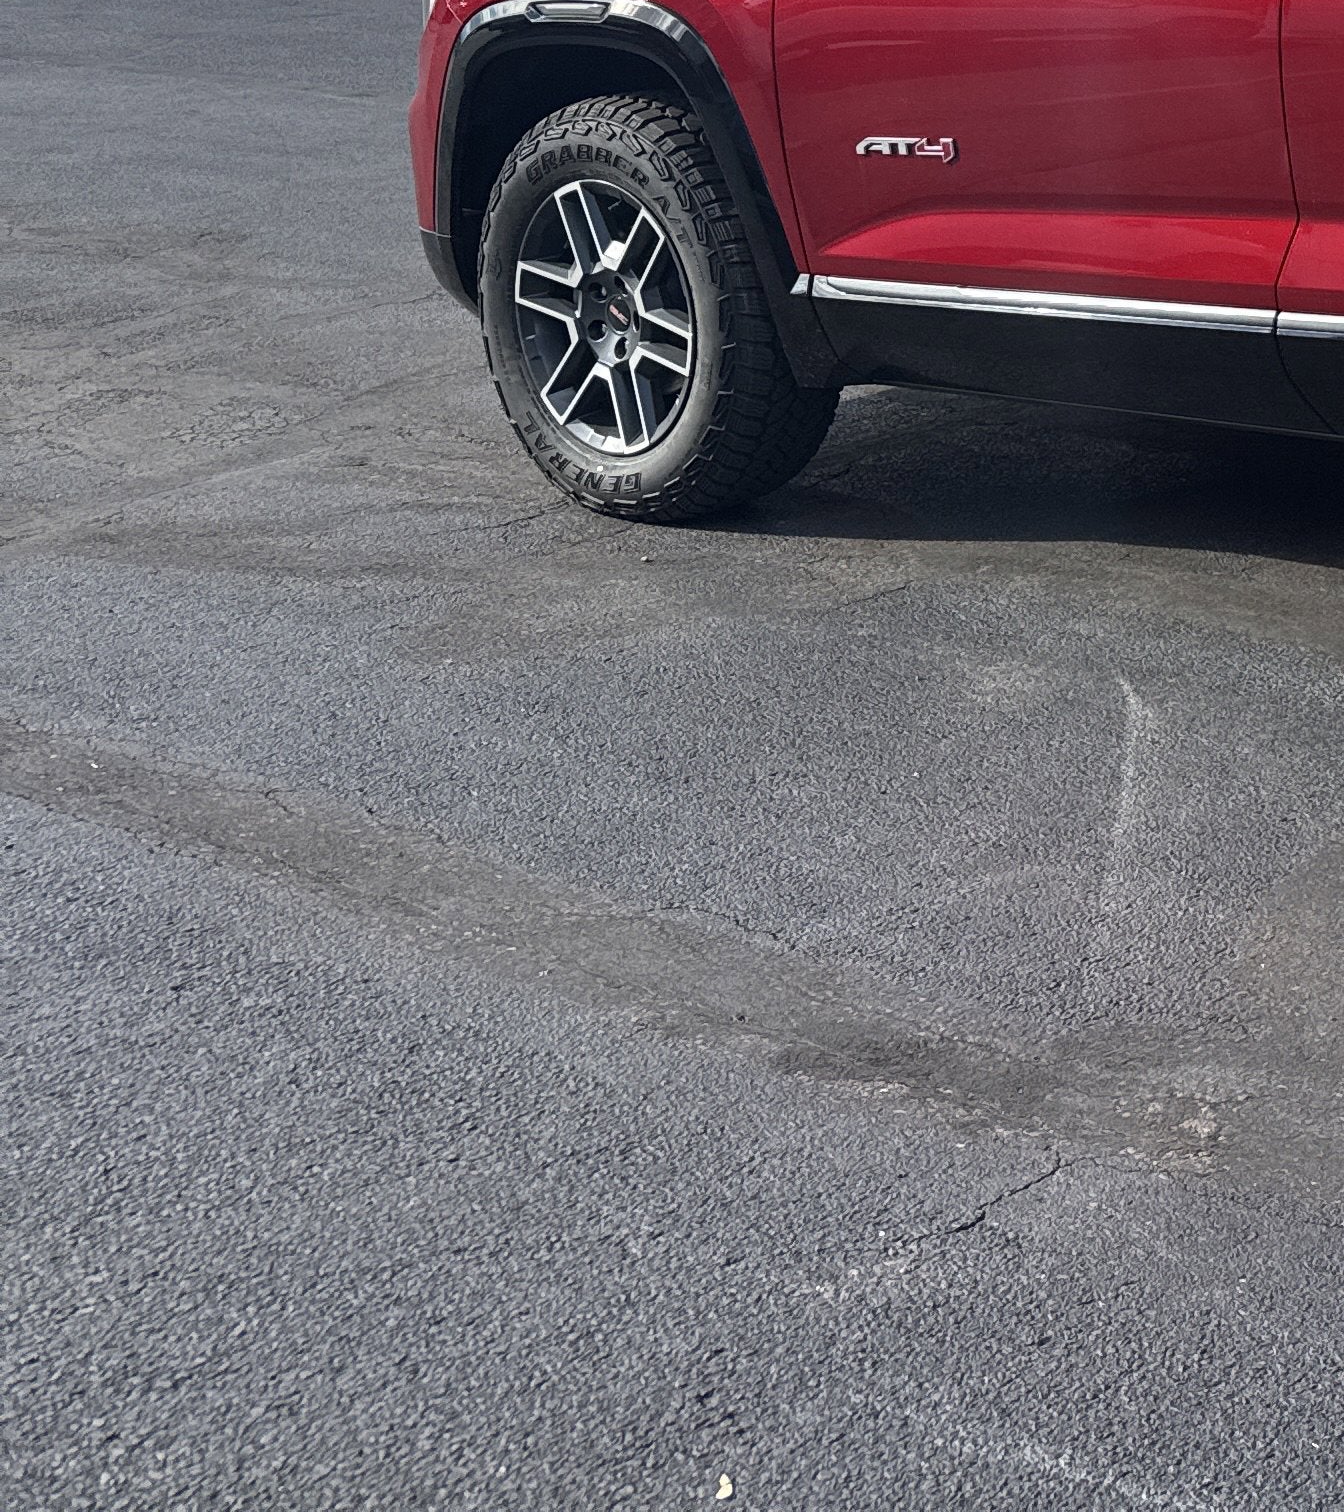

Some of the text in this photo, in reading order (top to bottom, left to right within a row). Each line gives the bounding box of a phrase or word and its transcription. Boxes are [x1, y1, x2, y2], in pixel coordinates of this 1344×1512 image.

[856, 136, 955, 163] AT4
[526, 144, 694, 249] GRABBER A/T
[523, 411, 642, 494] GENERAL
